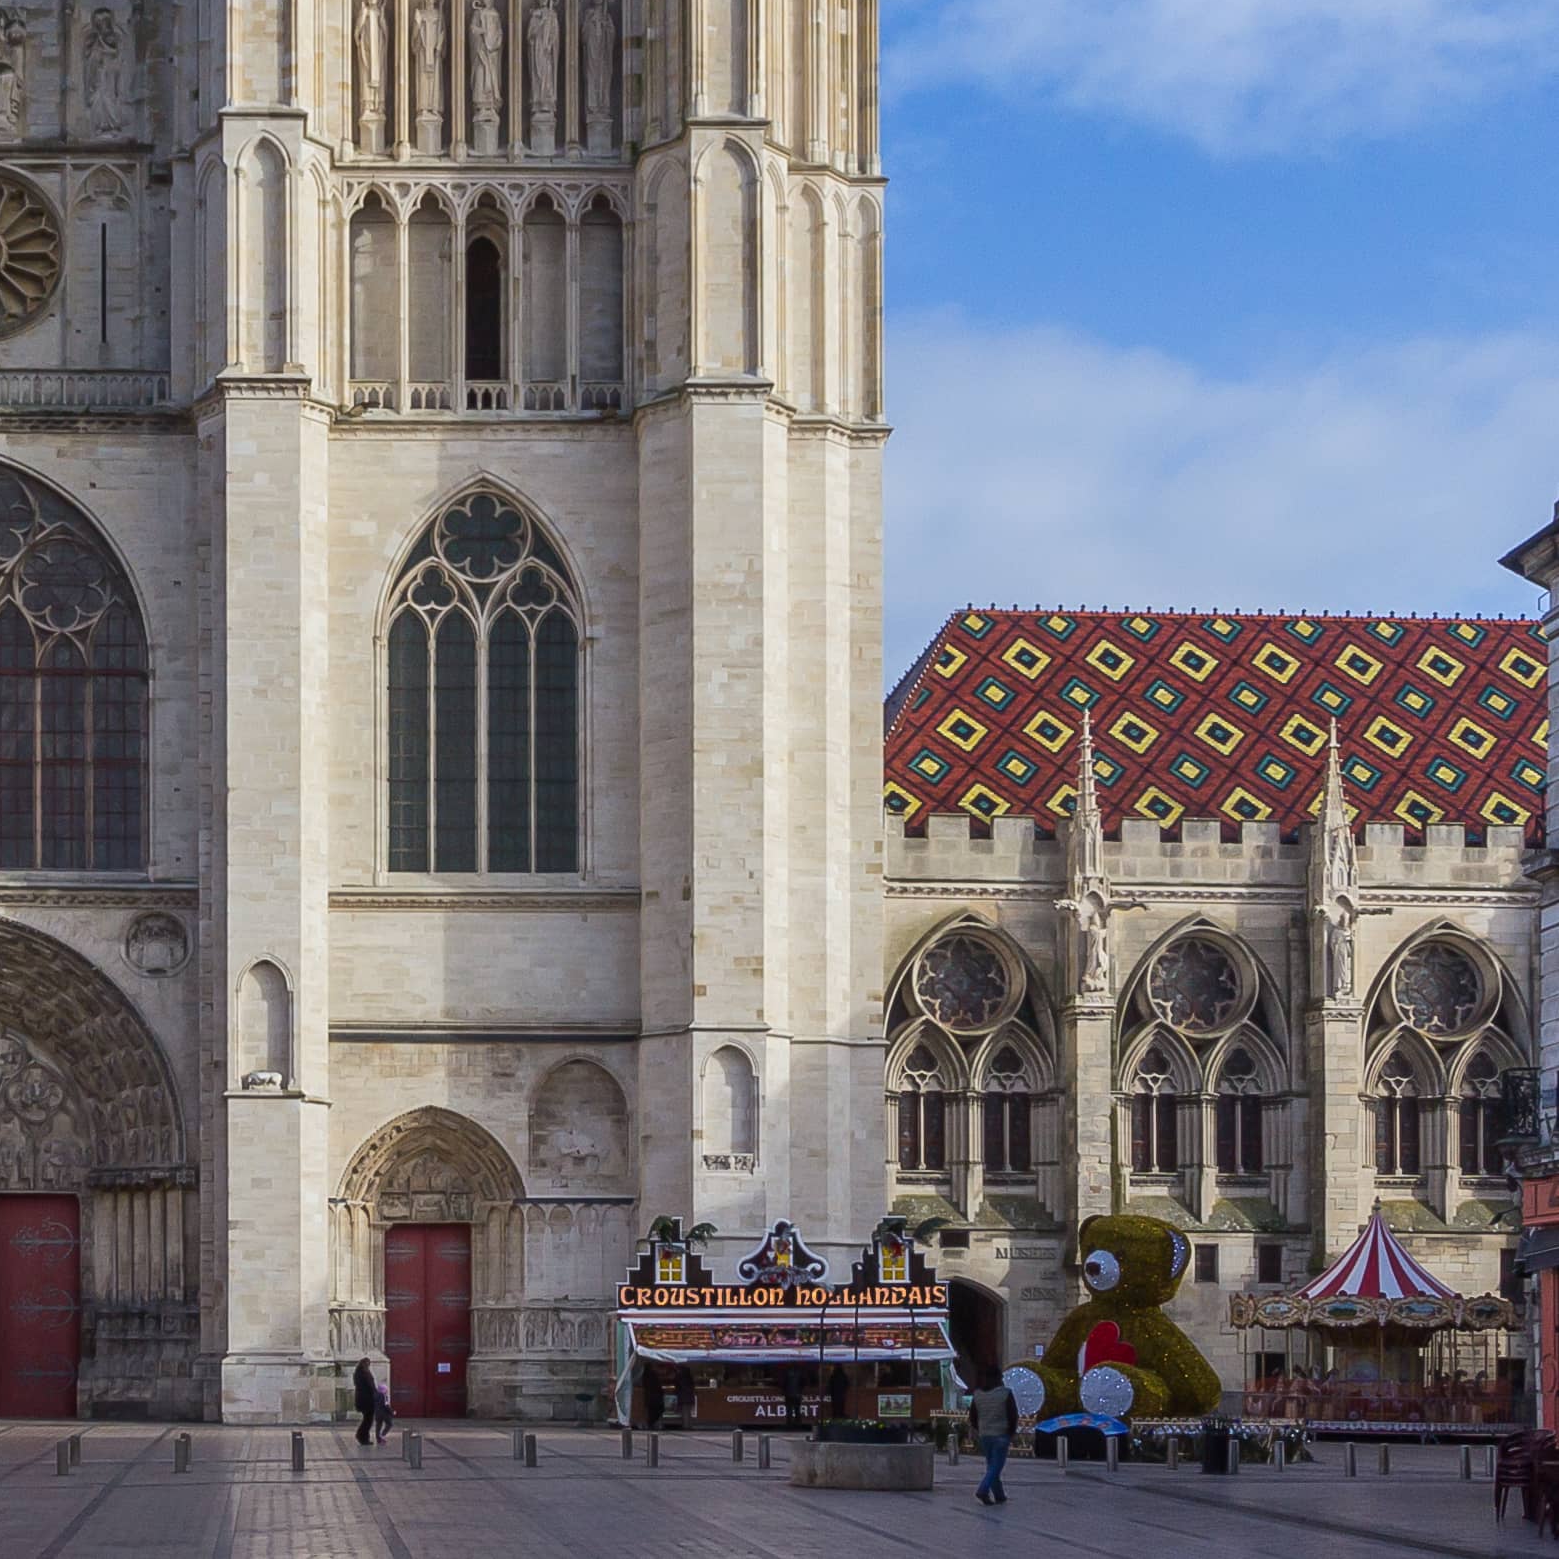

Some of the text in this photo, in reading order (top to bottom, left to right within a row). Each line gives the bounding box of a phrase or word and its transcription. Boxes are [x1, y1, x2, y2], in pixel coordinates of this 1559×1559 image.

[619, 1285, 947, 1306] CROUSTILLON HOLLANDAIS
[754, 1404, 819, 1418] ALBRT
